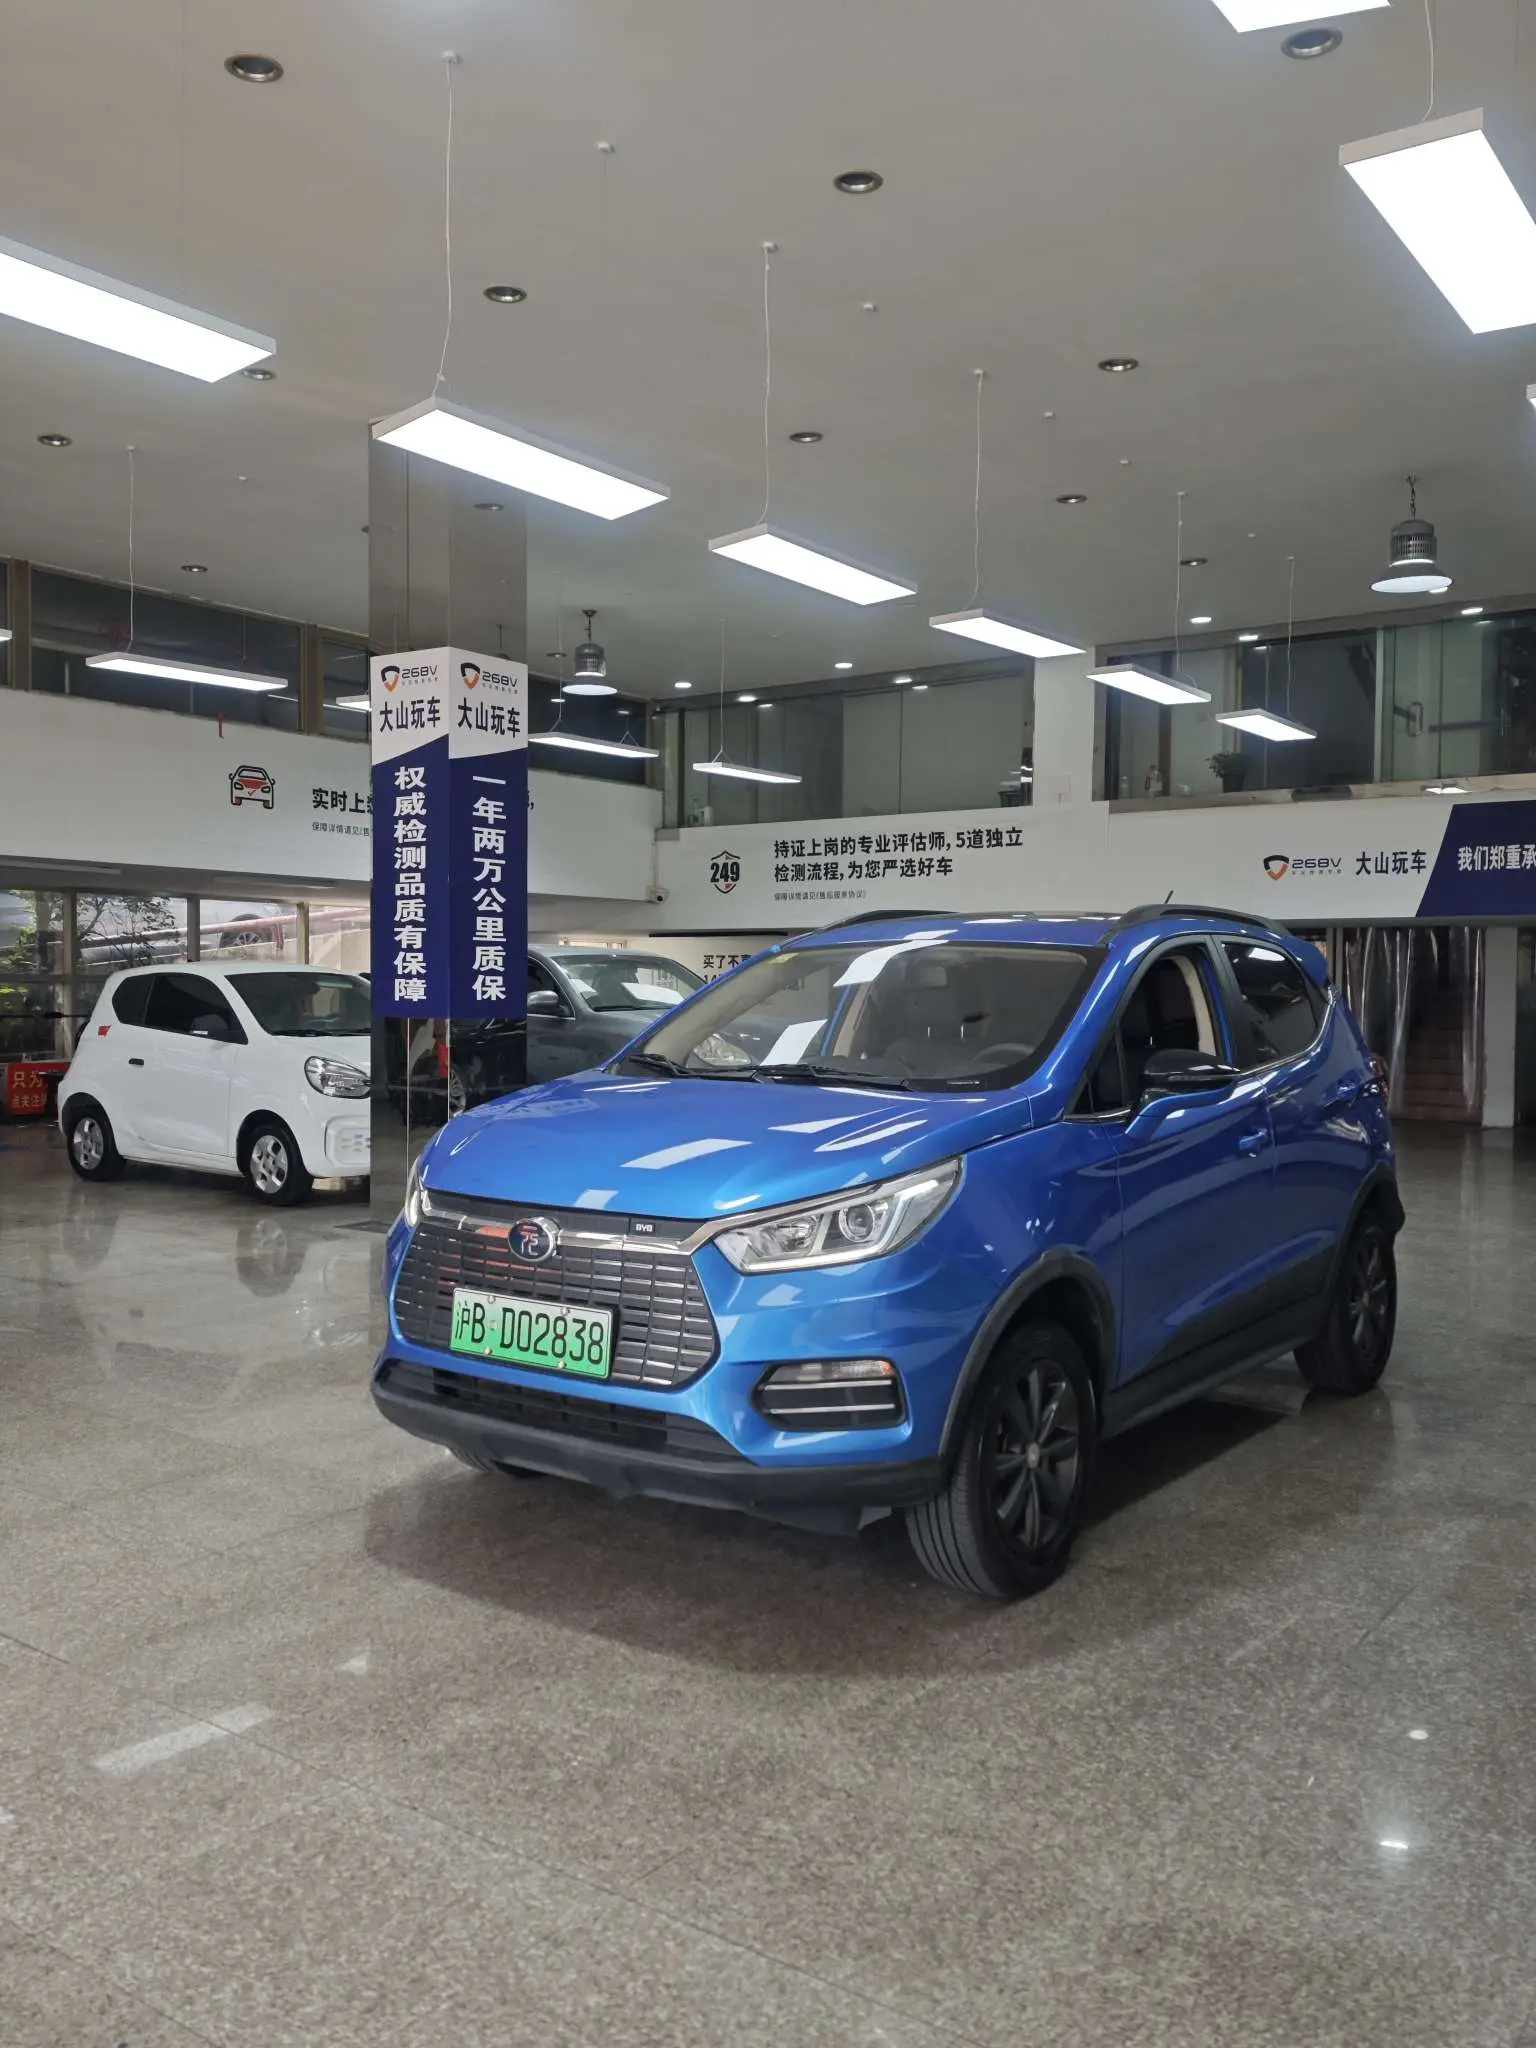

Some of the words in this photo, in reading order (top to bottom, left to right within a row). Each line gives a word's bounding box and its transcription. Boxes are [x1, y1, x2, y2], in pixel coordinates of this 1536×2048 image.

[401, 664, 438, 679] 268V
[482, 671, 519, 688] 268V
[379, 696, 441, 733] 大山玩车
[457, 697, 521, 738] 大山玩车
[710, 861, 740, 883] 249
[1292, 857, 1342, 869] 268V
[1355, 849, 1428, 876] 大山玩车
[393, 766, 427, 1002] 权威检测品质有保障
[472, 775, 507, 1001] 一年两万公里质保
